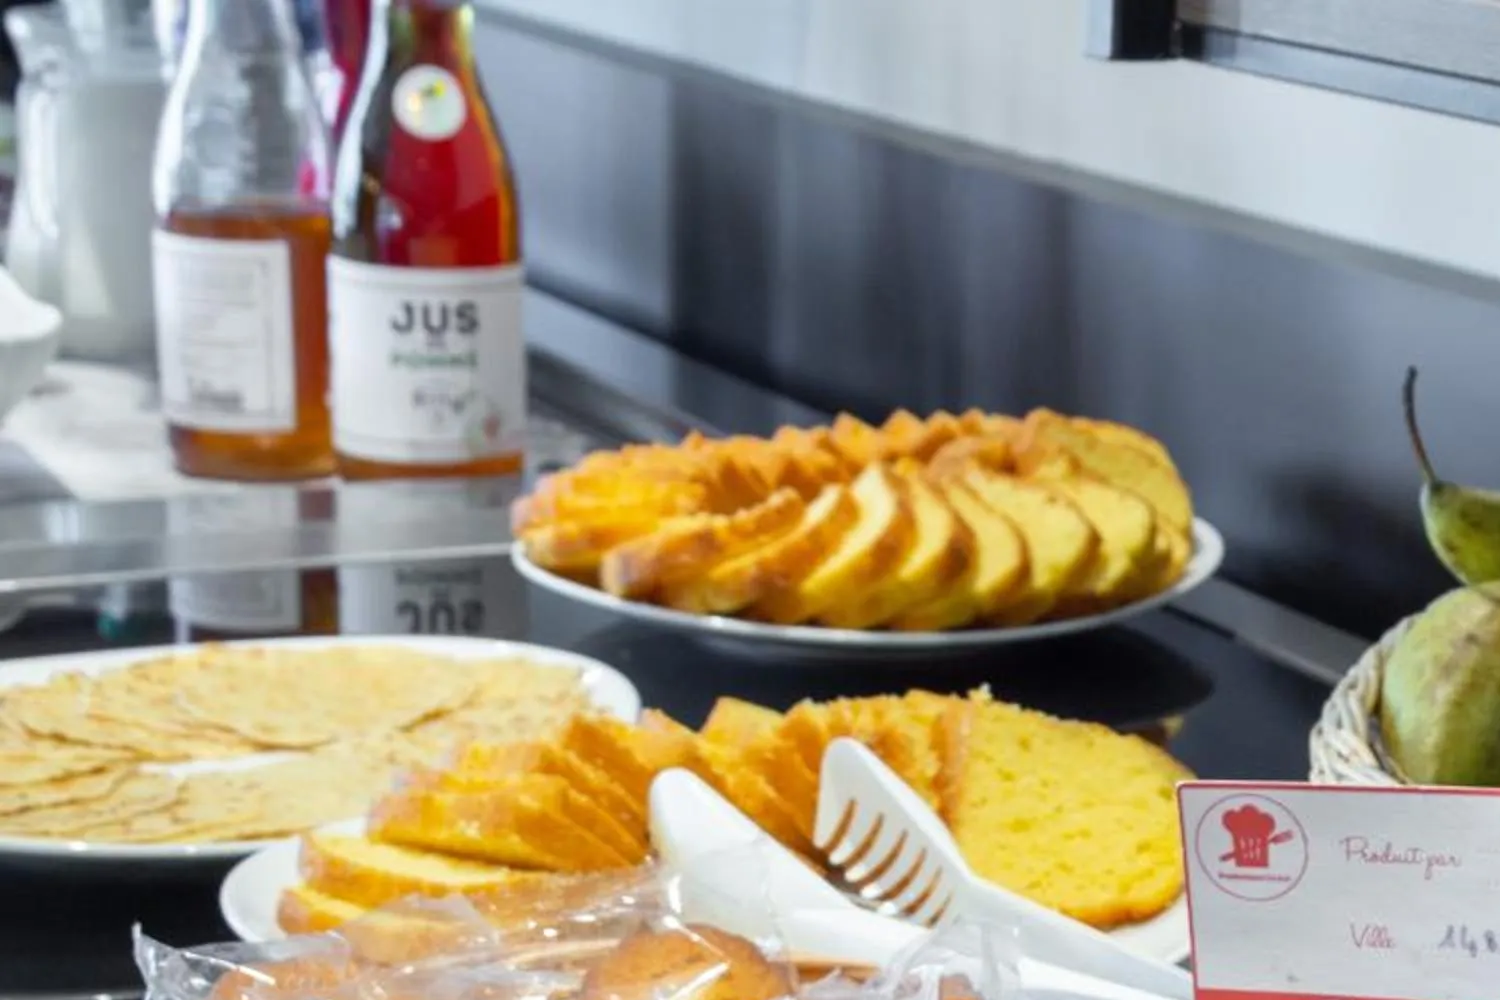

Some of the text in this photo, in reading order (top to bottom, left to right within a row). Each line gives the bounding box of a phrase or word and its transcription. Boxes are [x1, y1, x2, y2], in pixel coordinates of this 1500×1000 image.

[390, 299, 480, 335] JUS
[1339, 835, 1462, 881] Produit par
[1350, 922, 1397, 950] Ville
